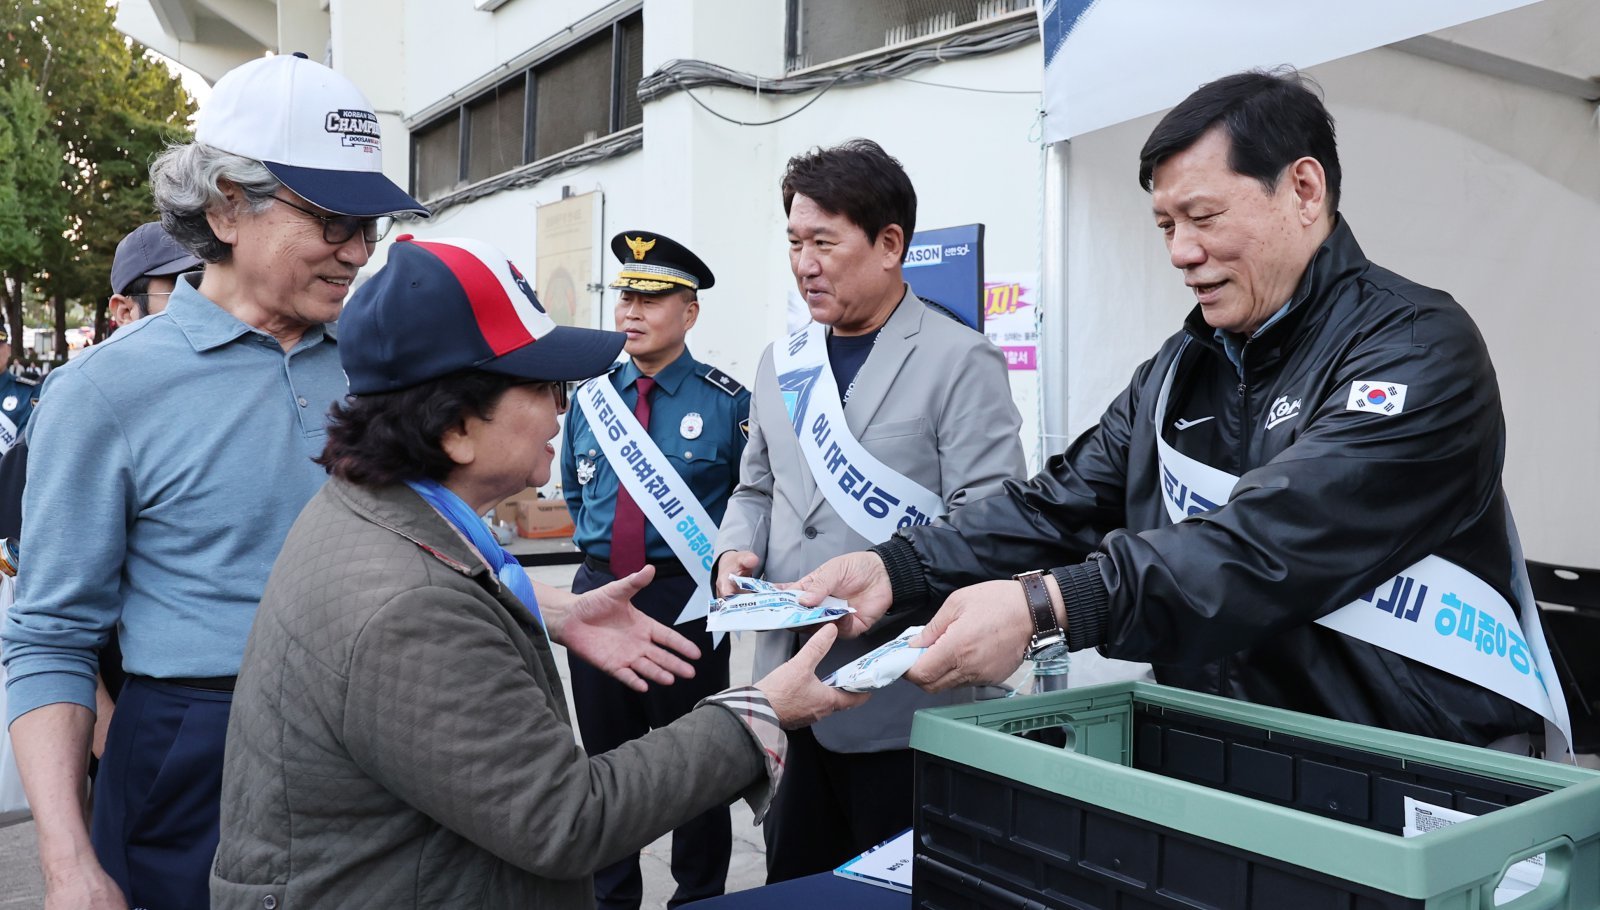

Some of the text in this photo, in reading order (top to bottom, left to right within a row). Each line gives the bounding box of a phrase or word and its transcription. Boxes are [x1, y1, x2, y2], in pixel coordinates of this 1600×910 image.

[343, 111, 367, 119] KOREAN
[907, 247, 940, 262] ASON
[984, 283, 1020, 316] 지!
[1003, 351, 1028, 365] 찰서
[591, 388, 628, 442] 국민이
[620, 439, 684, 520] 암표잡는
[823, 440, 901, 519] 국민이
[1434, 592, 1548, 697] 암행어
